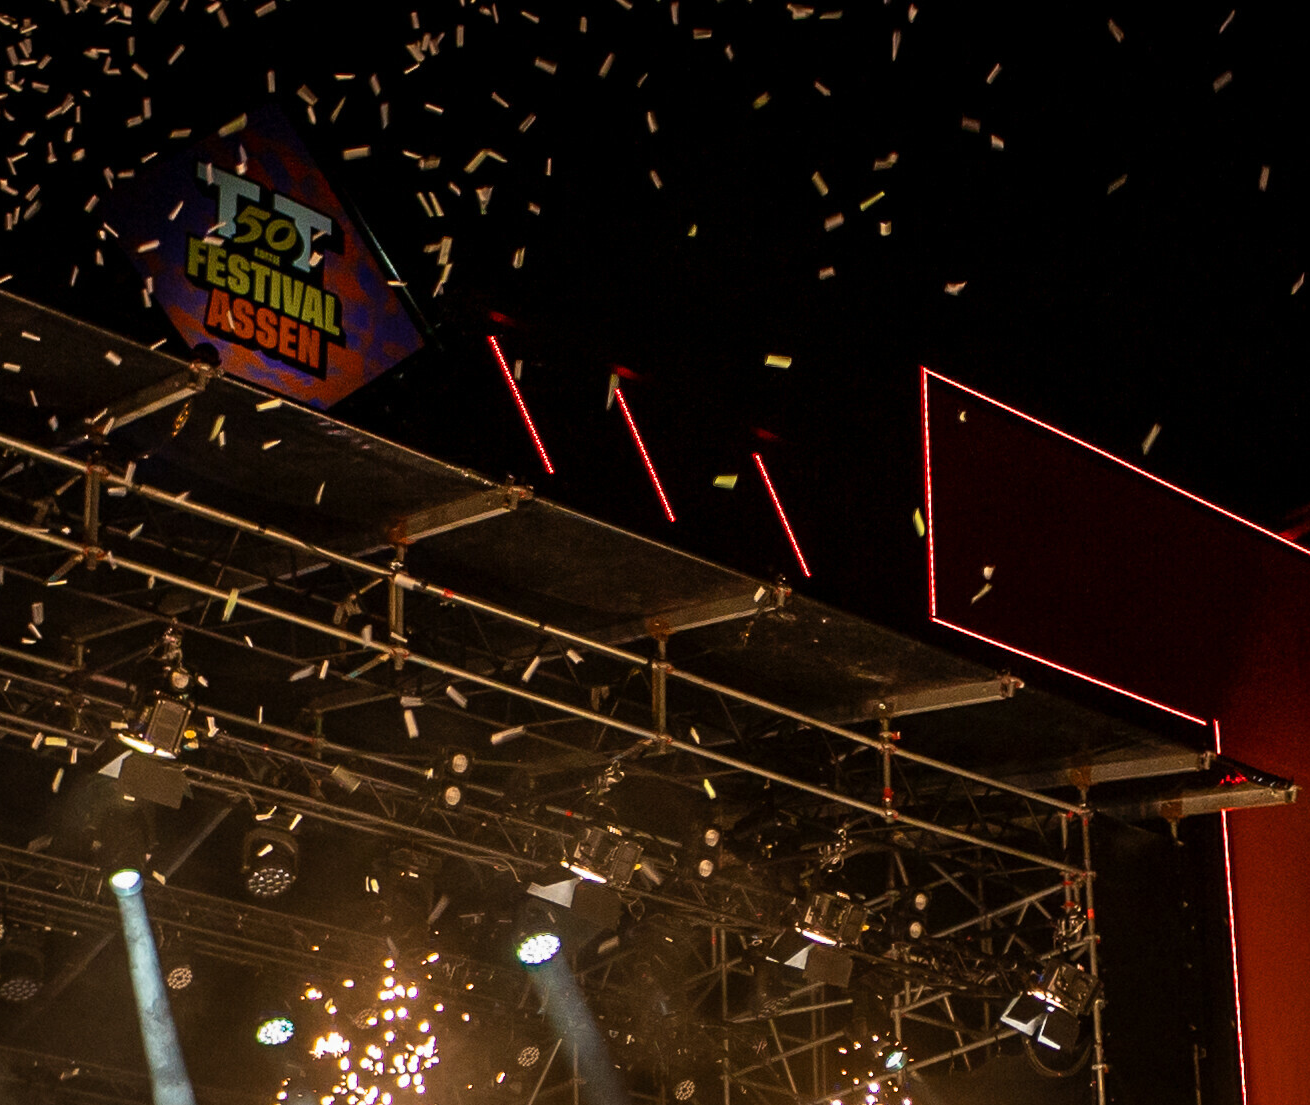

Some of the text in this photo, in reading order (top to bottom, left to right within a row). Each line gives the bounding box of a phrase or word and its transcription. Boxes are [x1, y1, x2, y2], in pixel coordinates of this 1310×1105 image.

[233, 205, 297, 251] 50
[187, 237, 340, 336] FESTIVAL
[206, 288, 321, 369] ASSEN
